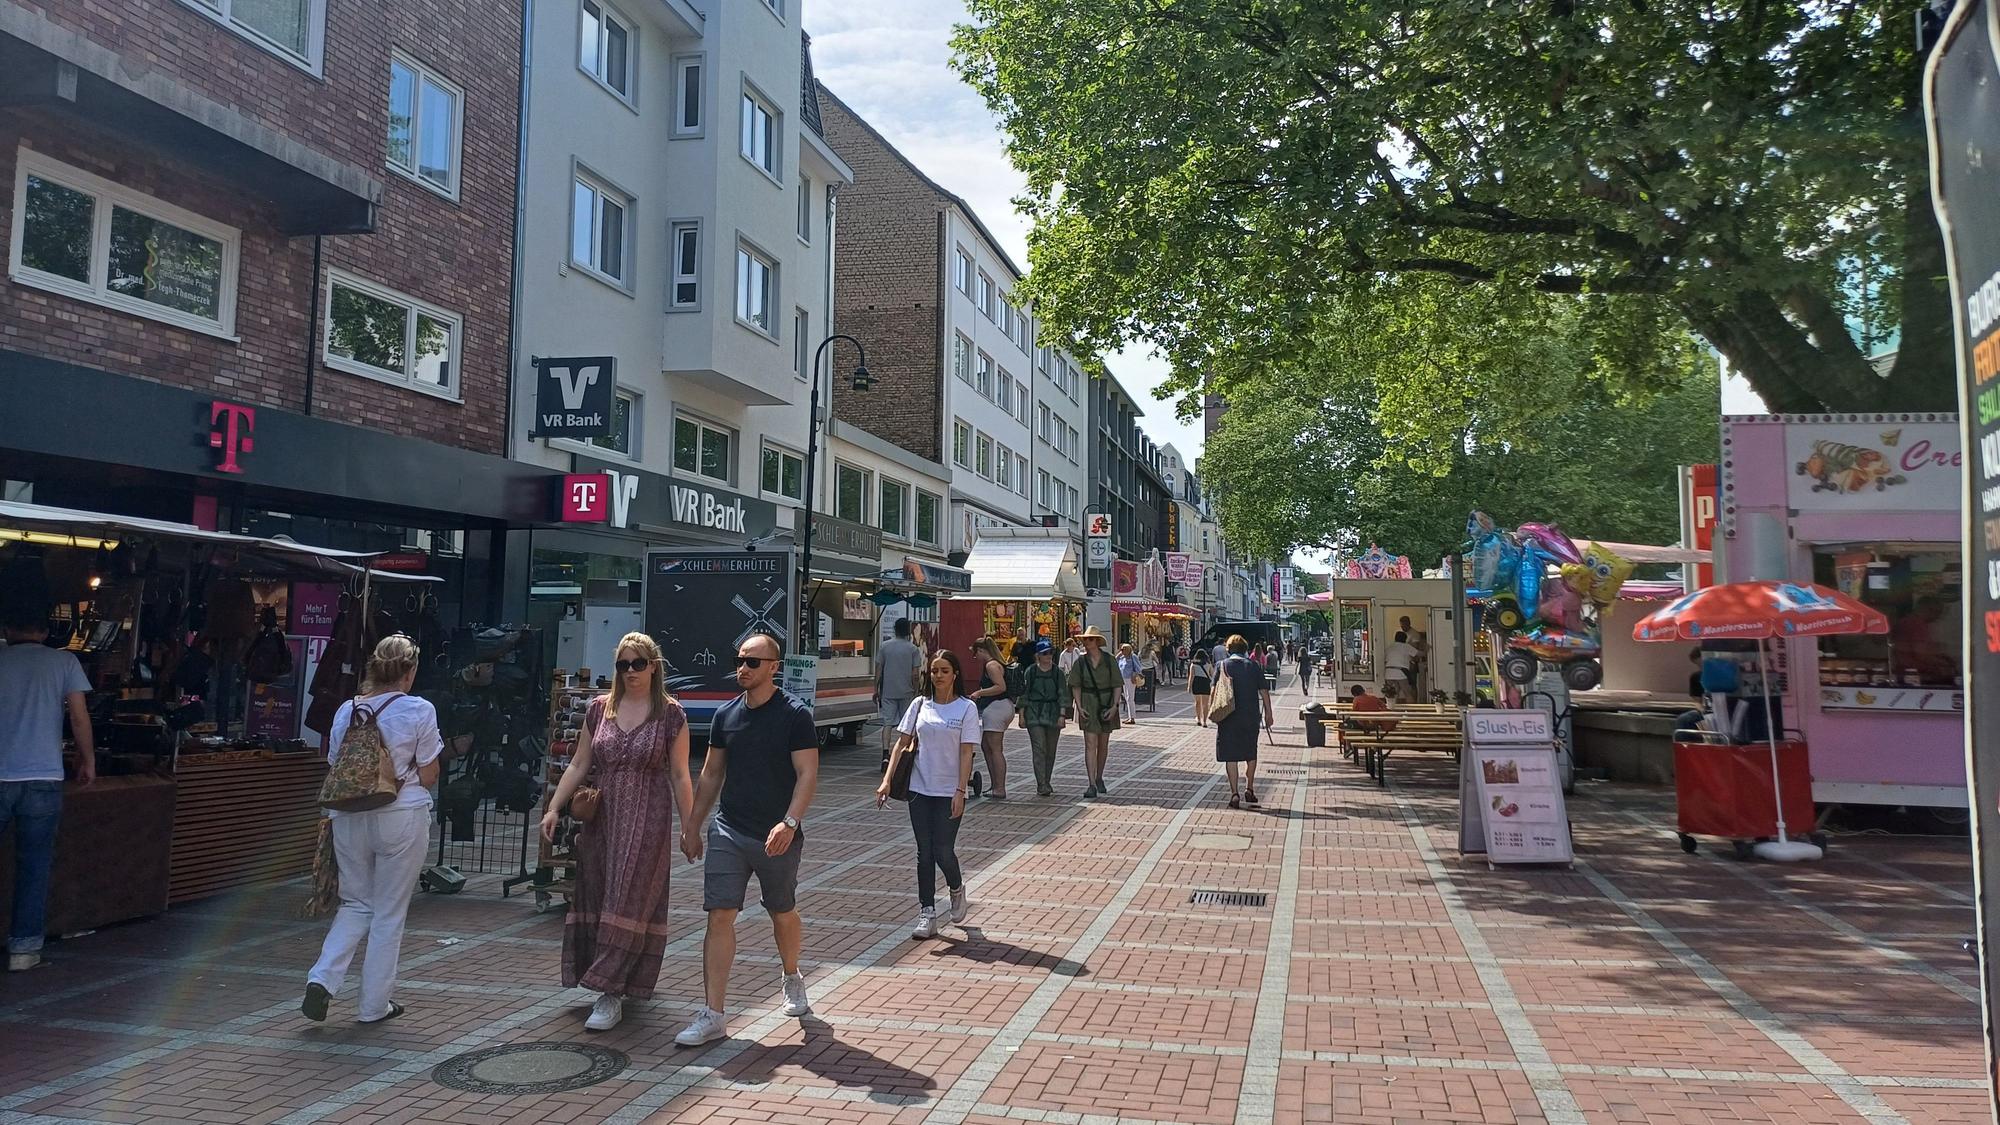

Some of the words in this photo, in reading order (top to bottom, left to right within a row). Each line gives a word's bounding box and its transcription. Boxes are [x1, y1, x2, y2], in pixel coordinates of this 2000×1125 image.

[542, 414, 563, 427] VR
[566, 412, 602, 427] Bank
[669, 485, 699, 524] VR
[701, 492, 746, 534] Bank
[682, 556, 776, 571] SCHLEMMERHÜTTE
[305, 604, 322, 613] Mehr
[323, 604, 328, 613] T
[301, 615, 315, 624] fürs
[315, 615, 332, 624] Team
[1476, 720, 1545, 735] Slush-Eis
